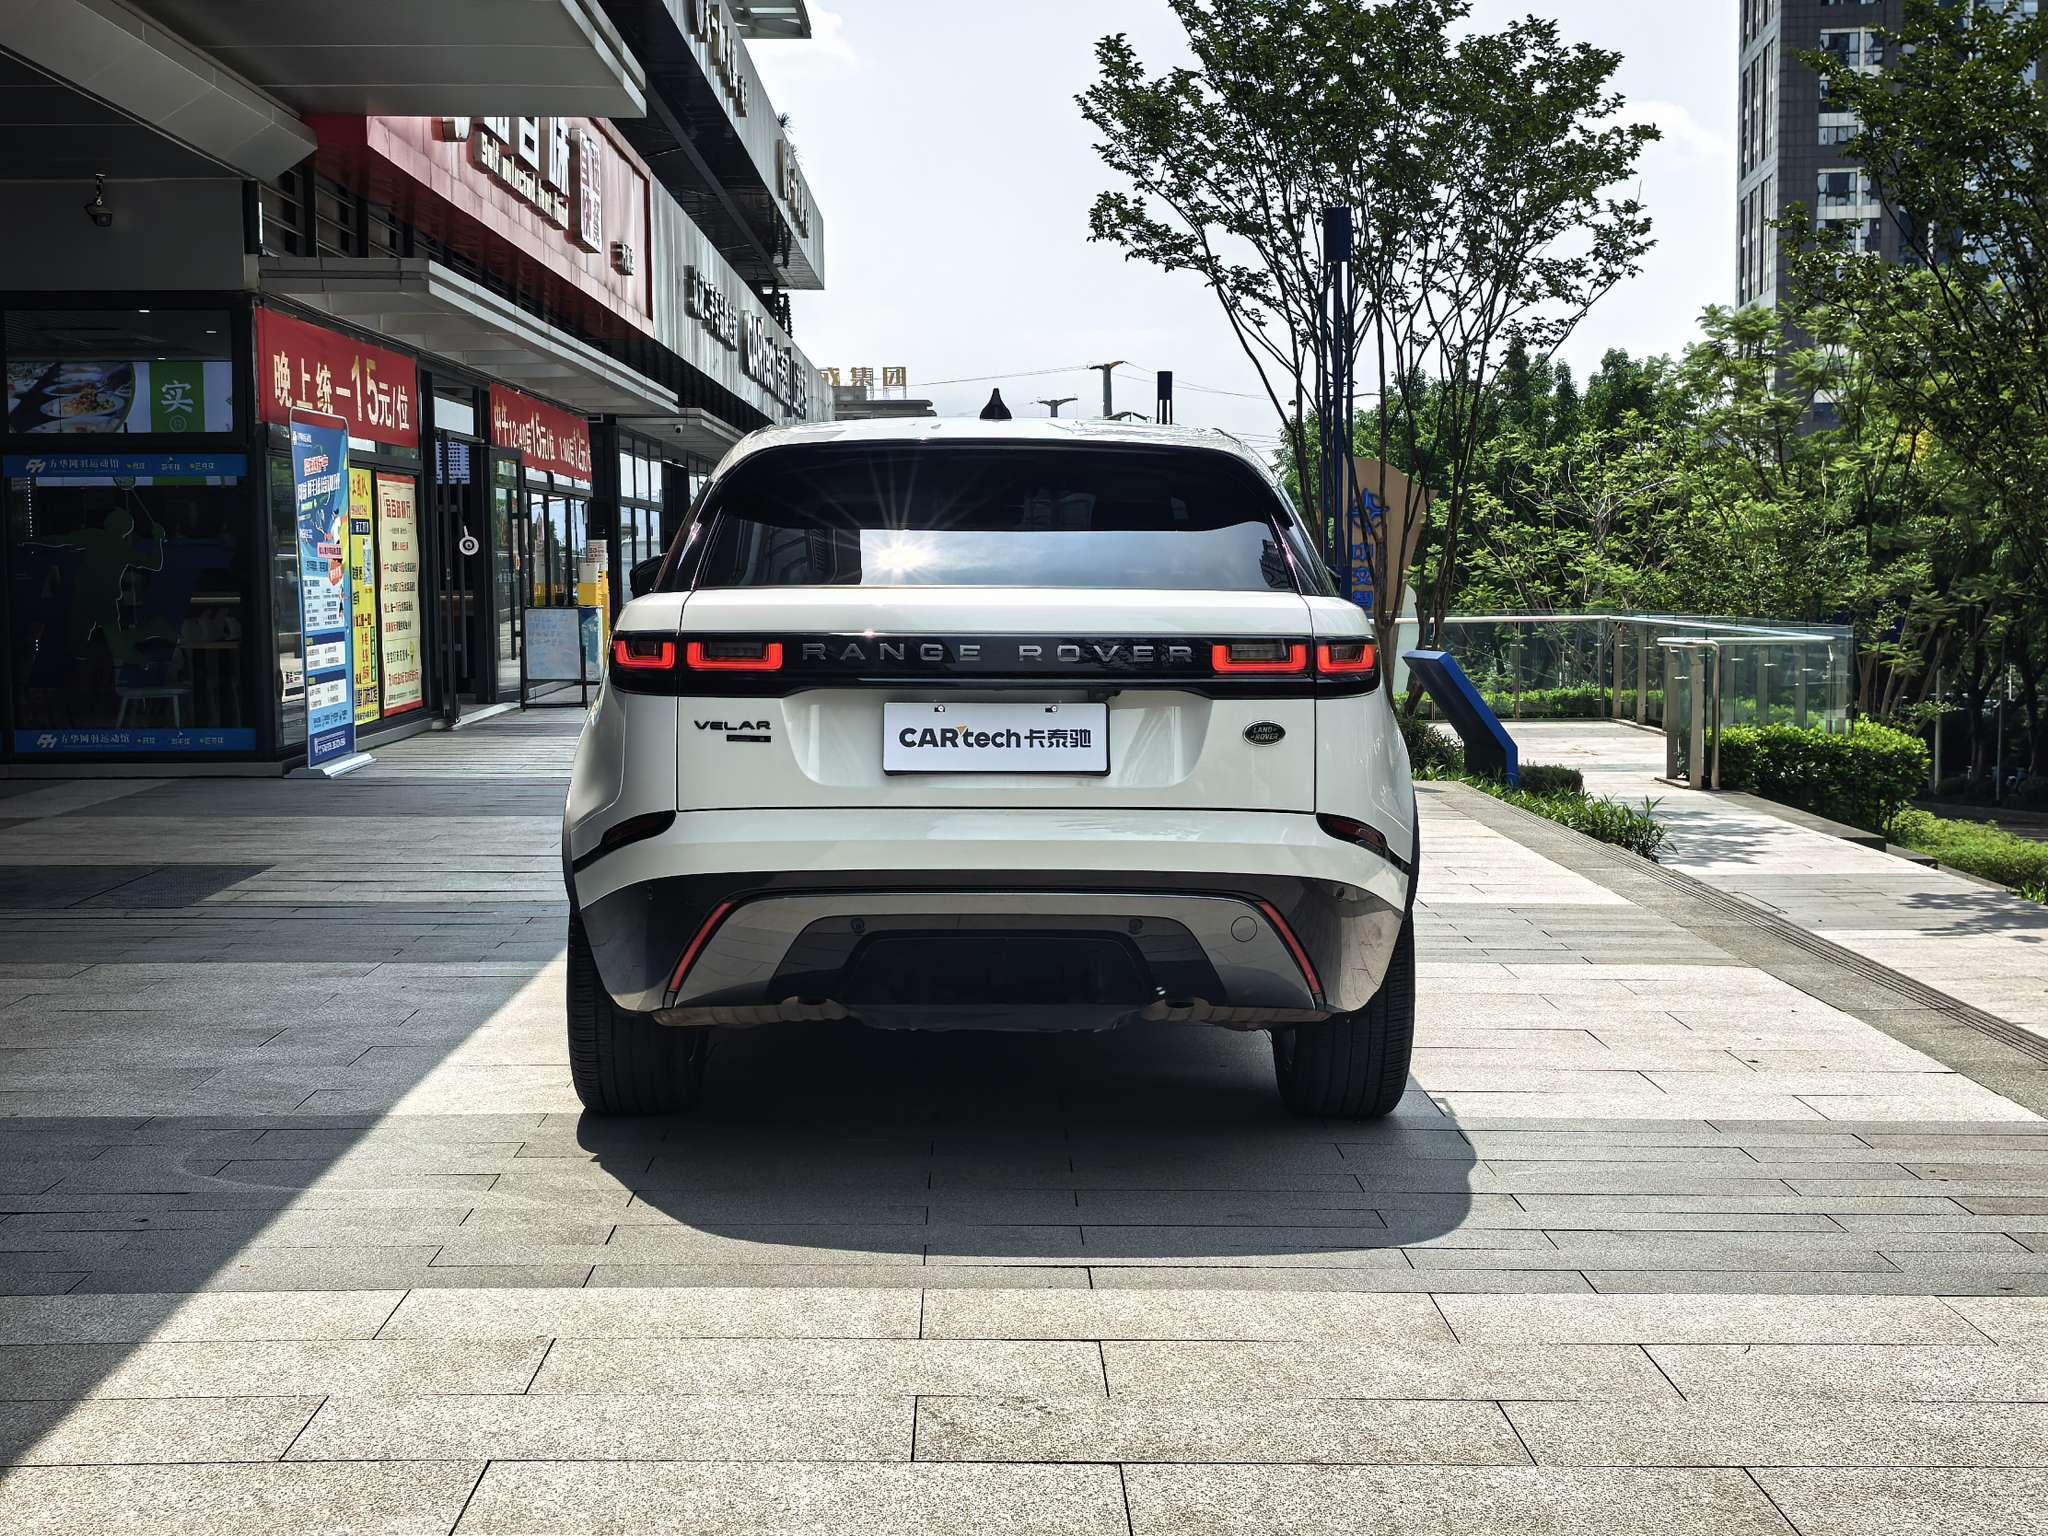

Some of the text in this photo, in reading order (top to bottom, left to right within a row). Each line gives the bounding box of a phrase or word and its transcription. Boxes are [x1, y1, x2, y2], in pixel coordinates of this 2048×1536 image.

[160, 380, 194, 414] 实
[802, 643, 1192, 662] RANGE ROVER
[694, 720, 771, 730] VELAR
